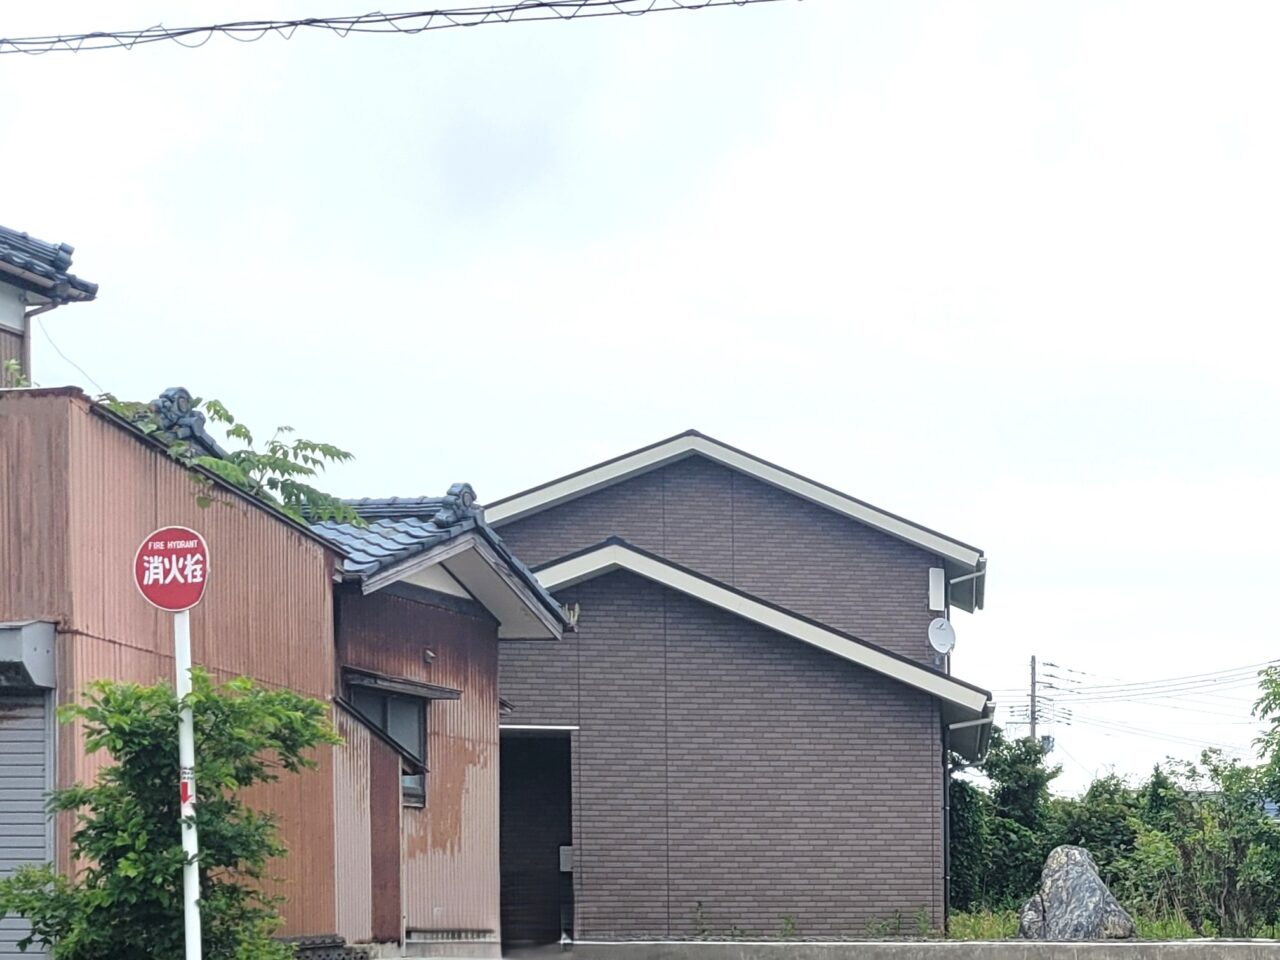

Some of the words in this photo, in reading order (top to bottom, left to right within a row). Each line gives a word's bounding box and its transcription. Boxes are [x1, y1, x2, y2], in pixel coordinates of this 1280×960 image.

[148, 541, 165, 550] FIRE
[167, 540, 199, 549] HYDRANT
[143, 553, 204, 585] 消火栓
